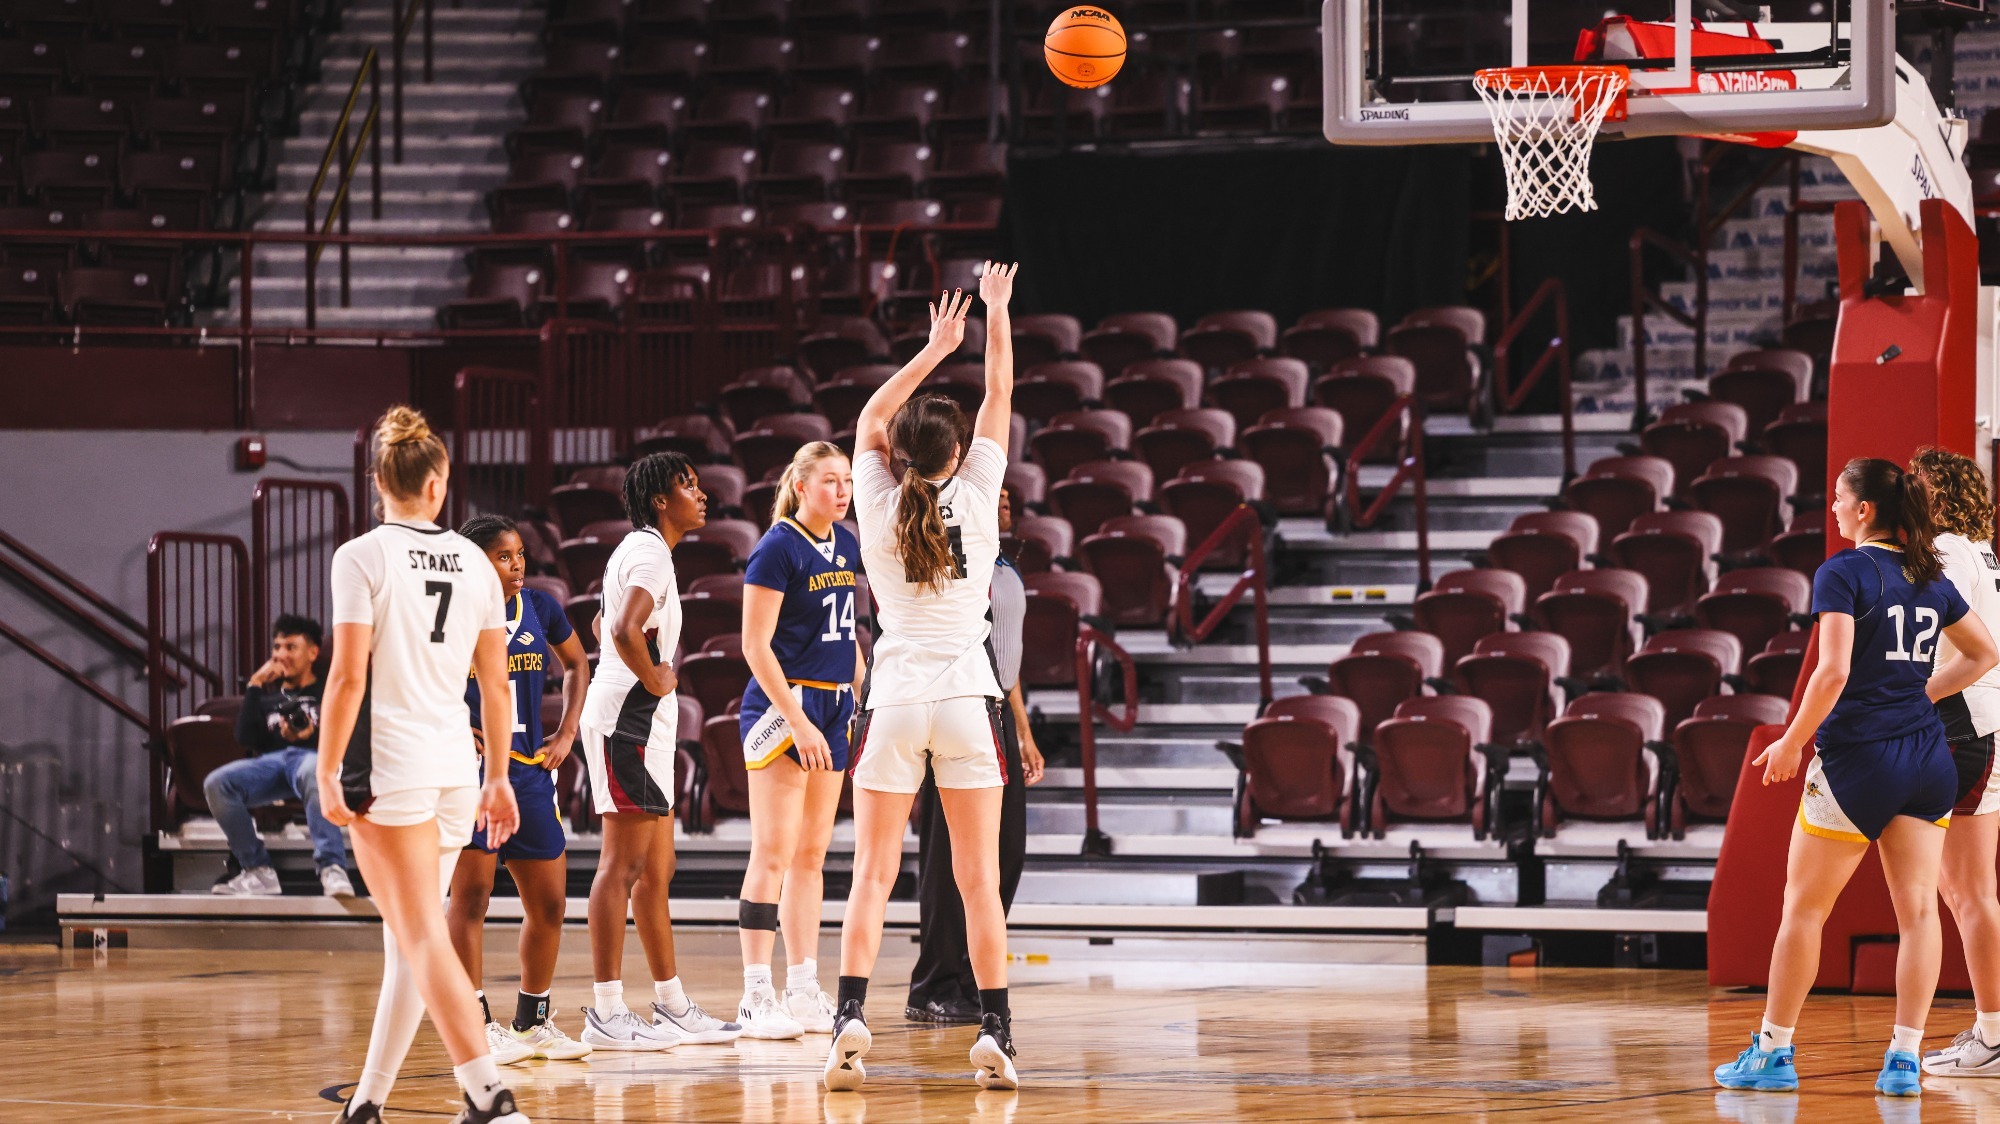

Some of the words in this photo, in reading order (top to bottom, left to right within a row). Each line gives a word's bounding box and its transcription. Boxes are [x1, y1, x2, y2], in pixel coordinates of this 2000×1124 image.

[1070, 9, 1110, 22] NCAA
[1360, 108, 1409, 121] SPALDING
[1911, 153, 1935, 199] SPAL
[809, 571, 856, 592] ANTEATER
[425, 580, 452, 643] 7
[821, 591, 857, 642] 14
[1885, 604, 1939, 662] 12
[751, 736, 764, 751] UC
[761, 715, 786, 741] IRVIN
